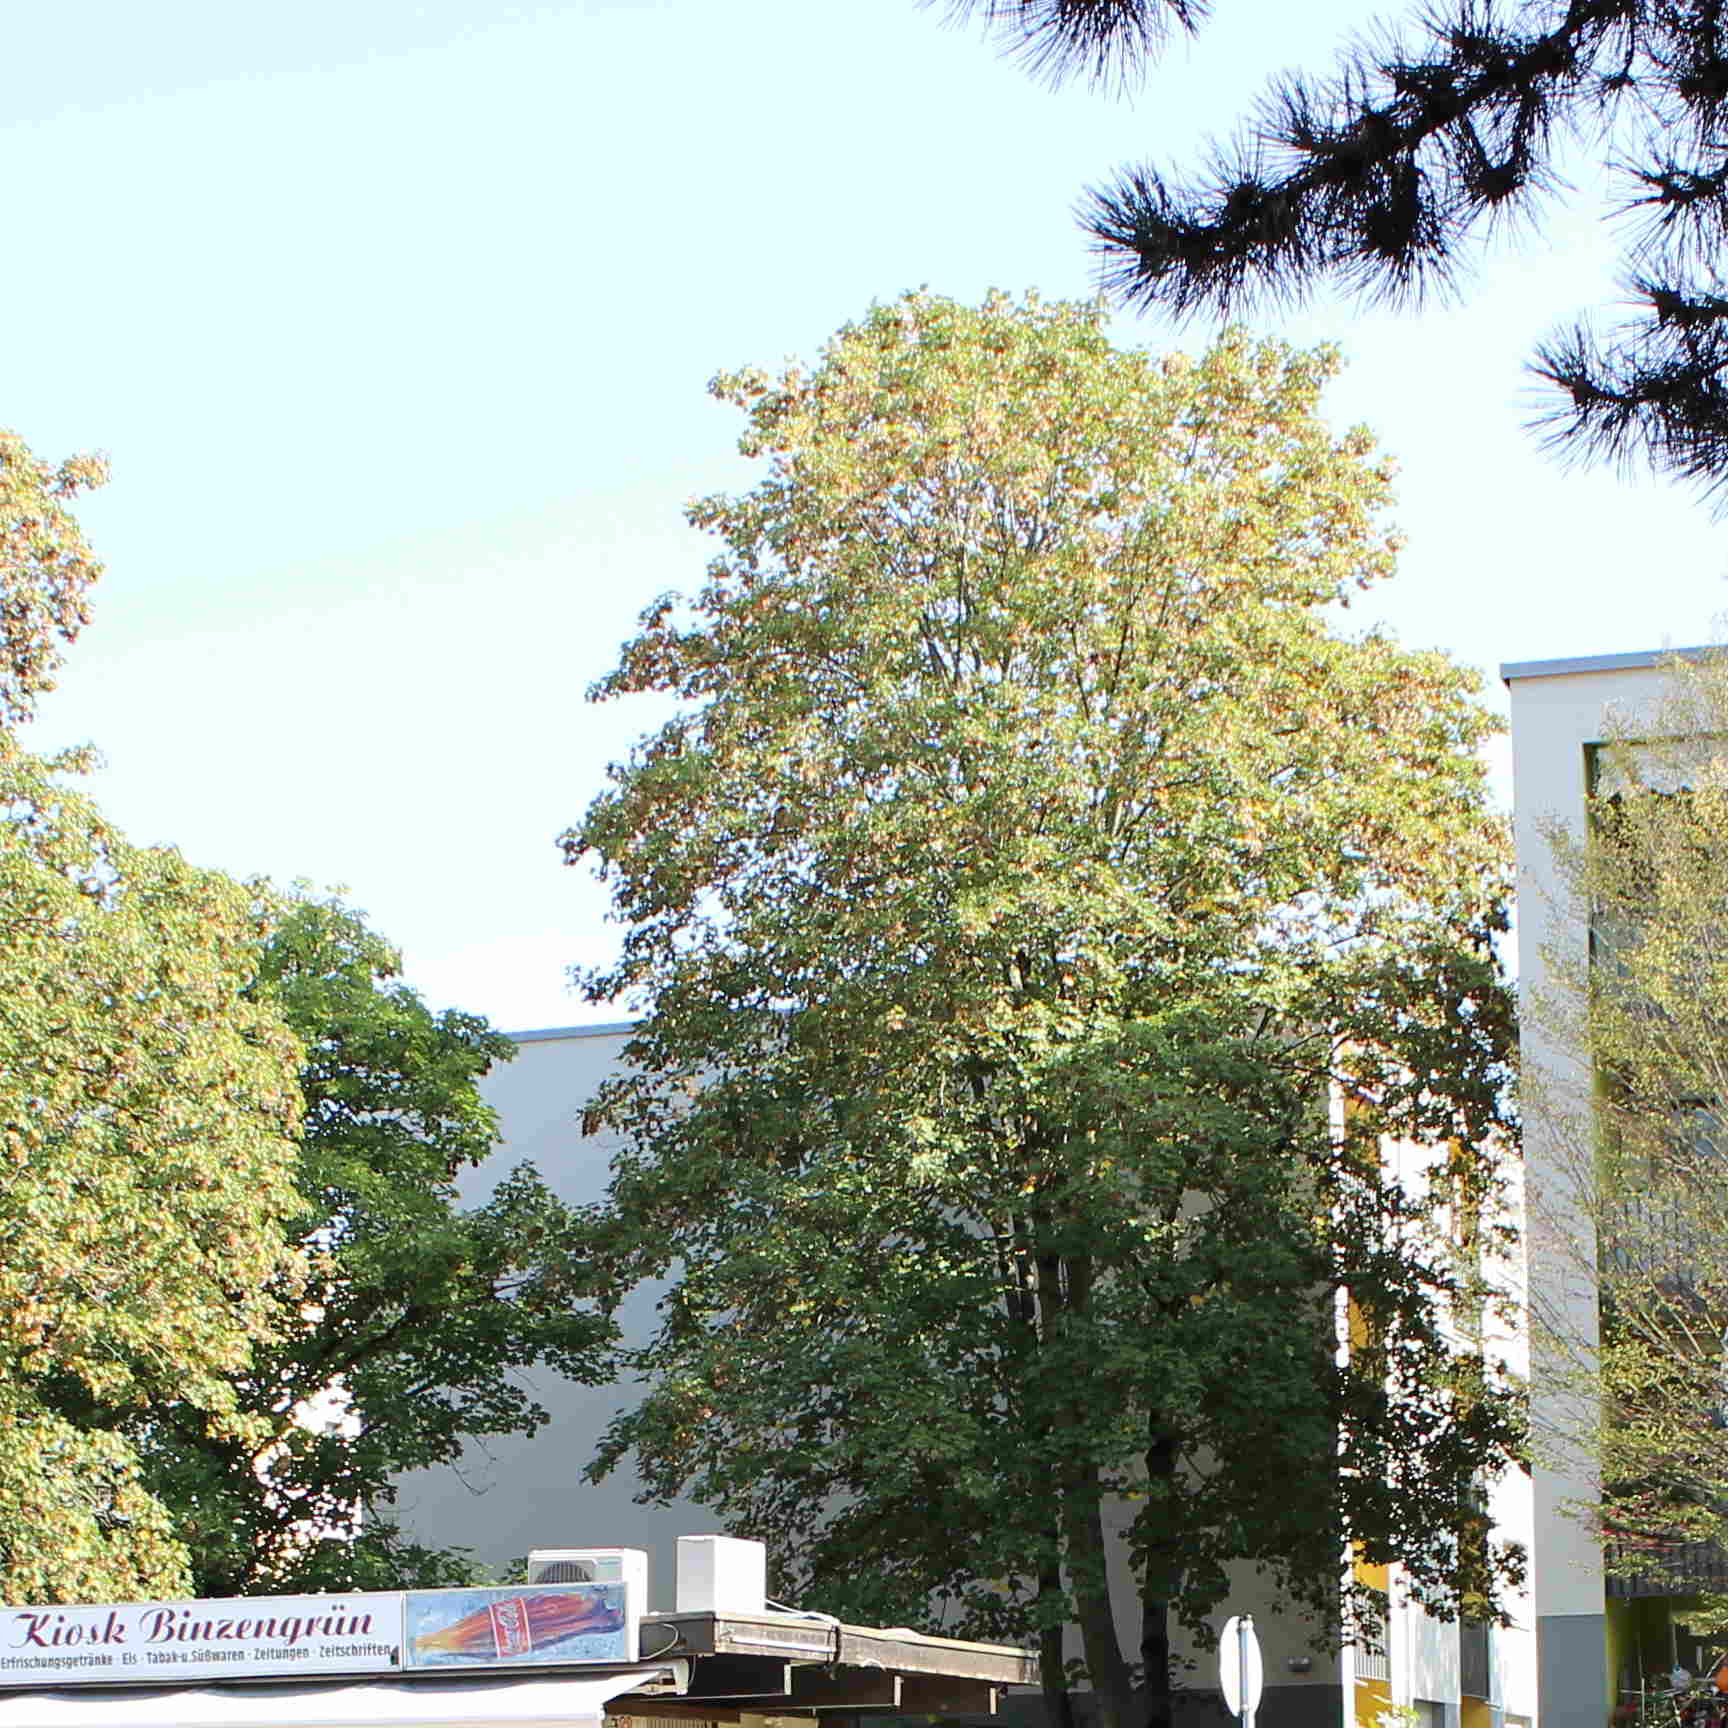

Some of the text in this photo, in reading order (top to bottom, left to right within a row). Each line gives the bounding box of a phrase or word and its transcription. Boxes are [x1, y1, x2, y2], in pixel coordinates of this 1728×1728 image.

[8, 1605, 373, 1648] Kiosk Binzengrün
[0, 1653, 113, 1671] Erfrischungsgetränke
[122, 1654, 137, 1665] Eis
[253, 1646, 310, 1661] Zeitungen
[319, 1643, 391, 1659] Zeitschriften
